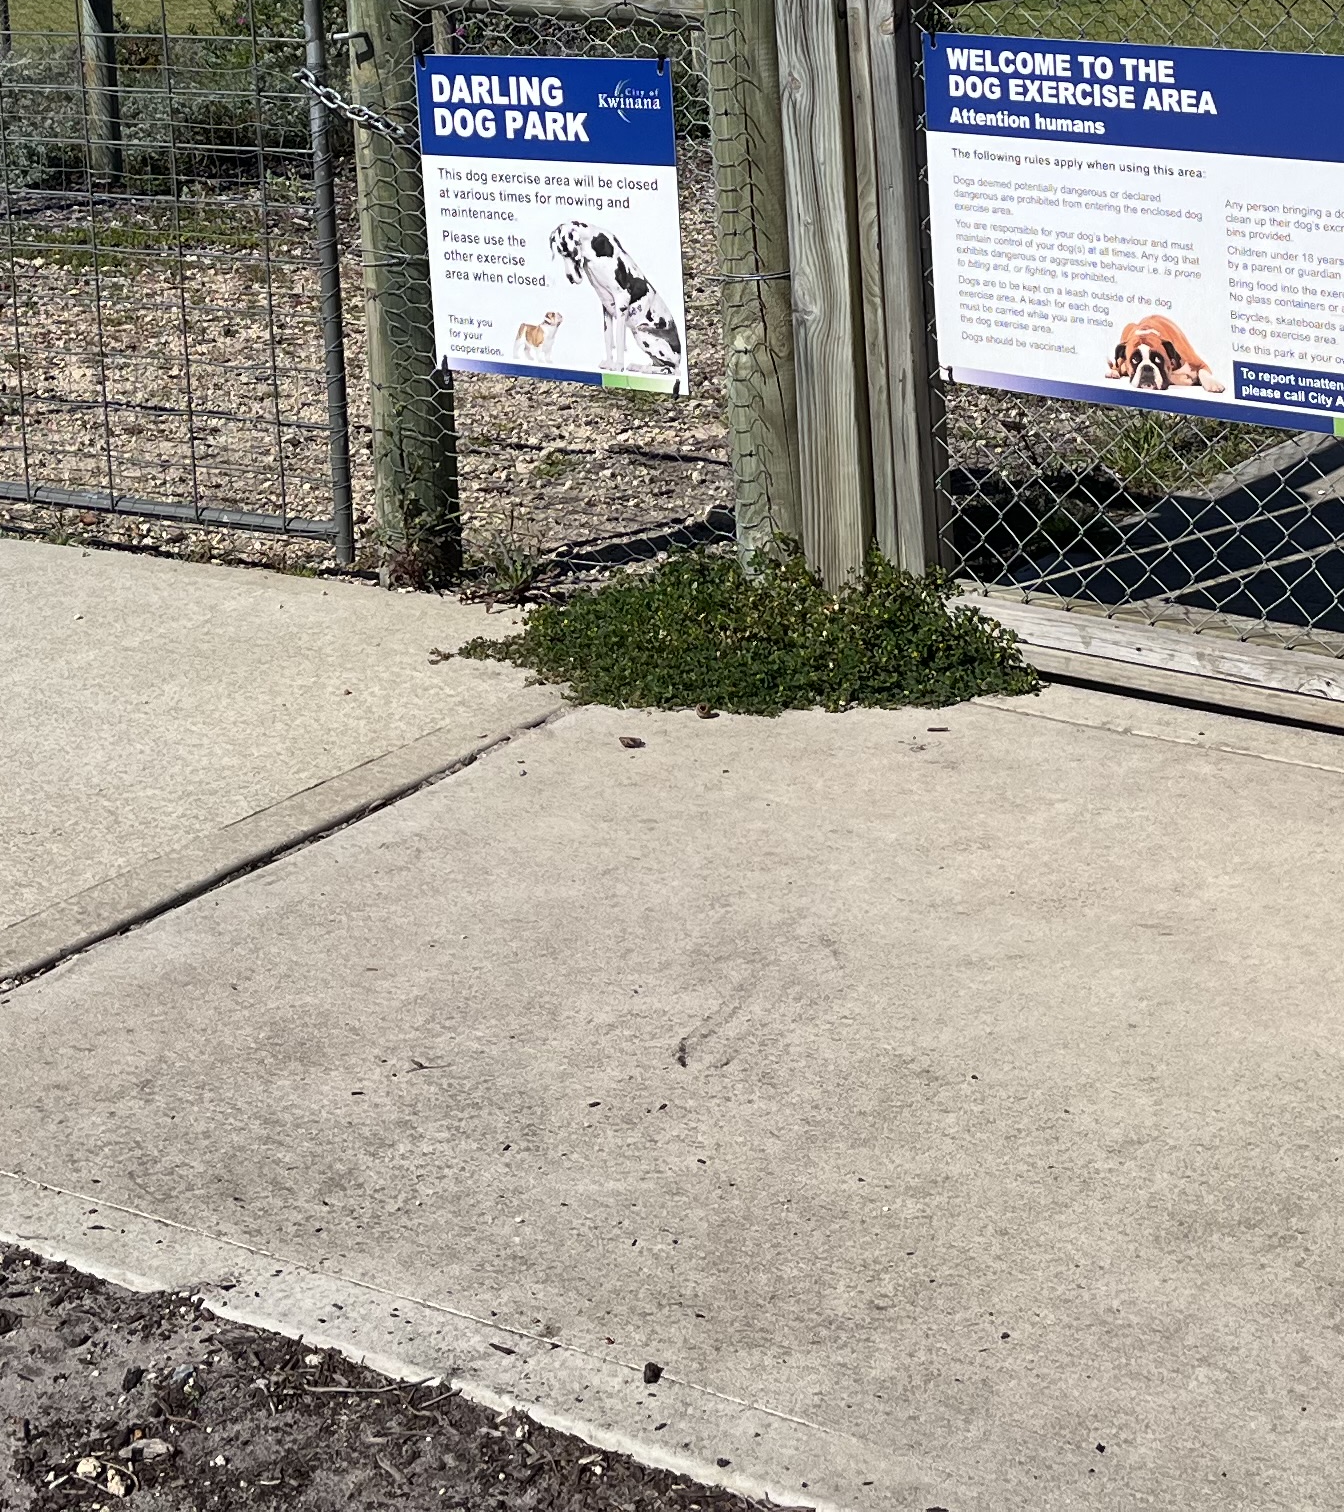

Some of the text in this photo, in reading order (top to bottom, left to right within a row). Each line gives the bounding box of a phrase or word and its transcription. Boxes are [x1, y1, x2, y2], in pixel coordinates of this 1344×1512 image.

[945, 47, 1176, 84] WELCOME TO THE
[430, 73, 564, 107] DARLING
[648, 87, 659, 97] of
[948, 73, 1218, 115] DOG EXERCISE AREA
[597, 92, 661, 110] Kwinana
[433, 106, 590, 142] DOG PARK
[949, 106, 1106, 135] Attention humans
[950, 146, 1207, 179] The following rules apply when using this area:
[436, 166, 659, 191] This dog exercise area will be closed
[438, 186, 630, 211] at various times for mowing and
[1224, 198, 1244, 213] Any
[1245, 202, 1280, 213] person
[1281, 203, 1323, 220] bringing
[1324, 209, 1332, 218] a
[439, 206, 519, 222] maintenance.
[1224, 212, 1252, 225] clean
[1253, 217, 1267, 228] up
[1268, 216, 1292, 228] their
[1292, 218, 1321, 233] dog's
[441, 228, 526, 248] Please use the
[1225, 226, 1247, 238] bins
[443, 248, 526, 267] other exercise
[1226, 244, 1268, 259] Children
[1269, 250, 1299, 262] under
[1316, 255, 1344, 267] years
[444, 268, 550, 287] area when closed.
[1226, 258, 1240, 272] by
[1241, 261, 1249, 271] a
[1250, 262, 1283, 274] parent
[1283, 266, 1296, 275] or
[1296, 267, 1342, 280] guardian
[1227, 276, 1254, 292] Bring
[1255, 279, 1278, 293] food
[1280, 282, 1300, 295] into
[1300, 284, 1318, 296] the
[1228, 290, 1244, 303] No
[1245, 293, 1272, 306] glass
[1273, 297, 1326, 312] containers
[1327, 303, 1339, 313] or
[447, 313, 493, 329] Thank you
[1274, 315, 1337, 331] skateboards
[448, 327, 483, 342] for your
[1229, 323, 1247, 335] the
[1247, 325, 1268, 340] dog
[1269, 329, 1311, 343] exercise
[1231, 341, 1252, 354] Use
[1252, 344, 1272, 356] this
[1272, 348, 1296, 359] park
[1297, 351, 1308, 360] at
[1309, 353, 1333, 364] your
[1239, 366, 1256, 381] To
[1257, 371, 1296, 386] report
[1241, 383, 1281, 399] please
[1283, 389, 1306, 402] call
[1307, 391, 1334, 408] City
